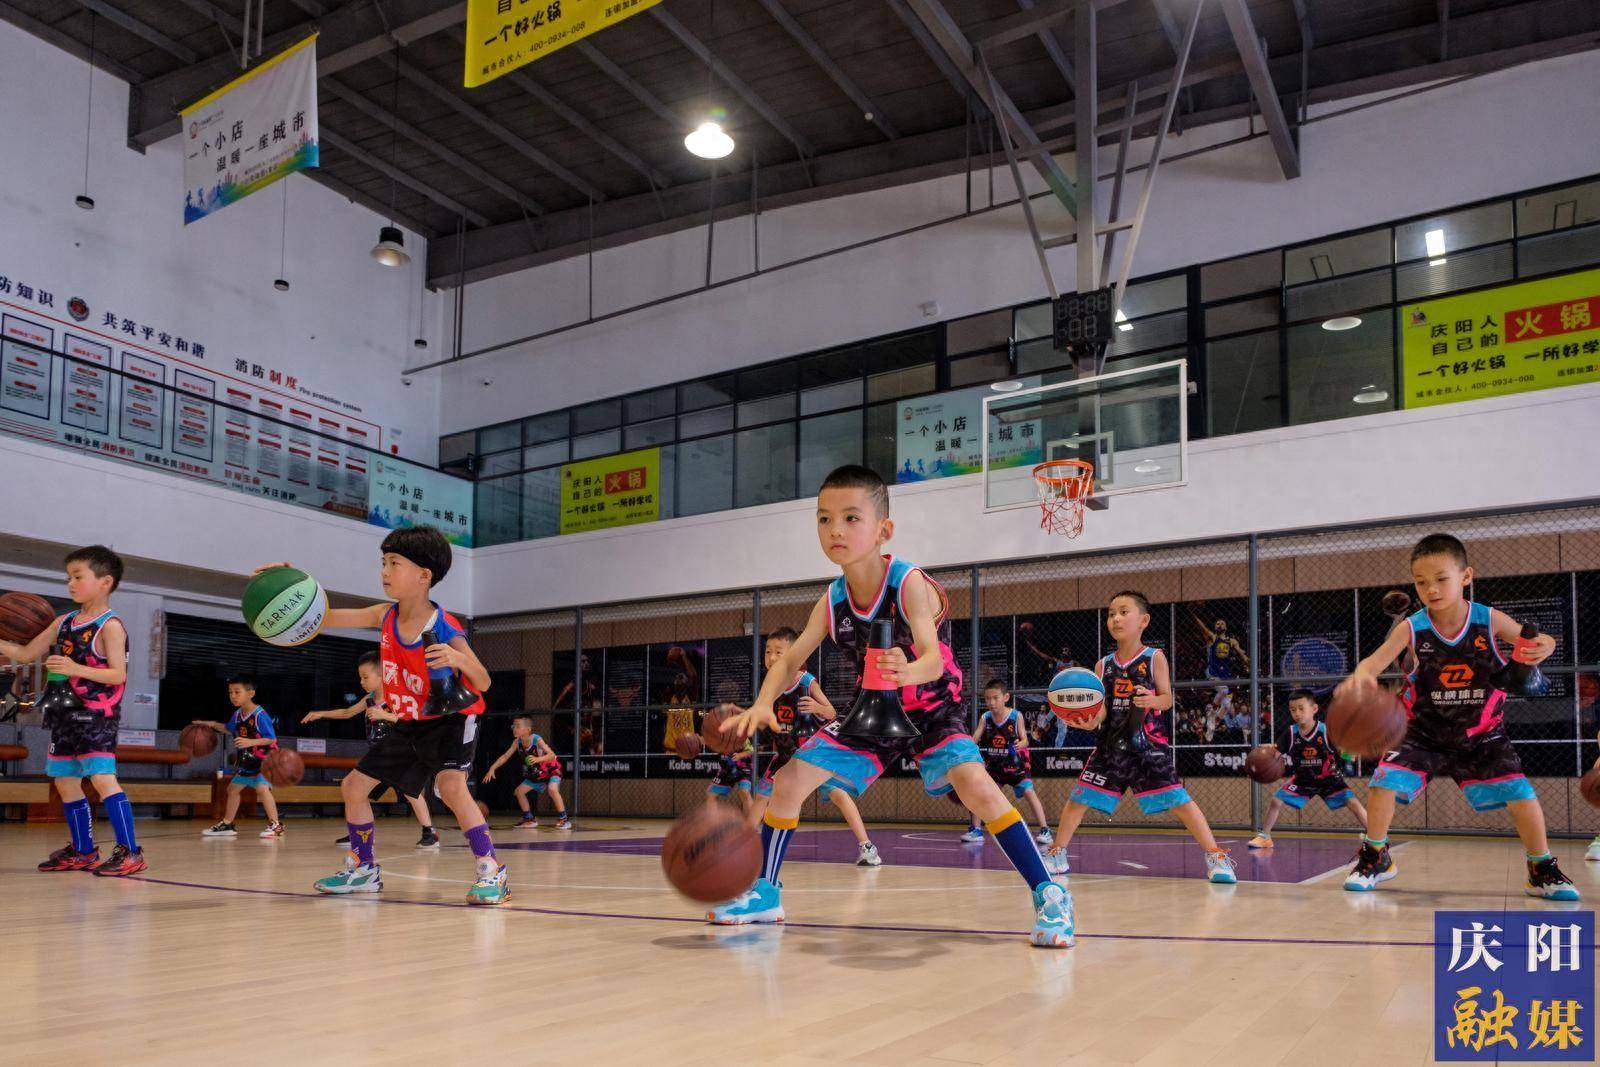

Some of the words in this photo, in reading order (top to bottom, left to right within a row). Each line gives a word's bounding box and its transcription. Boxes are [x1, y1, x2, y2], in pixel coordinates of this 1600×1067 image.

[484, 1, 562, 46] 一个好火锅
[189, 120, 243, 158] 一个小店
[217, 111, 305, 172] 温暖一座城市
[1431, 315, 1498, 339] 庆阳人
[1515, 301, 1592, 339] 火锅
[103, 312, 206, 359] 共筑平安和谐
[1432, 333, 1499, 357] 自己的
[1418, 354, 1507, 378] 一个好火锅
[1524, 338, 1600, 361] 一所好学
[235, 358, 298, 390] 消防制度
[905, 416, 967, 438] 一个小店
[377, 482, 424, 501] 一个小店
[608, 470, 642, 492] 火锅
[400, 500, 468, 526] 温暖一座城市
[261, 589, 305, 631] TARMAK
[669, 760, 692, 770] Kobe
[1046, 756, 1083, 769] Kevin
[1082, 770, 1107, 787] 25
